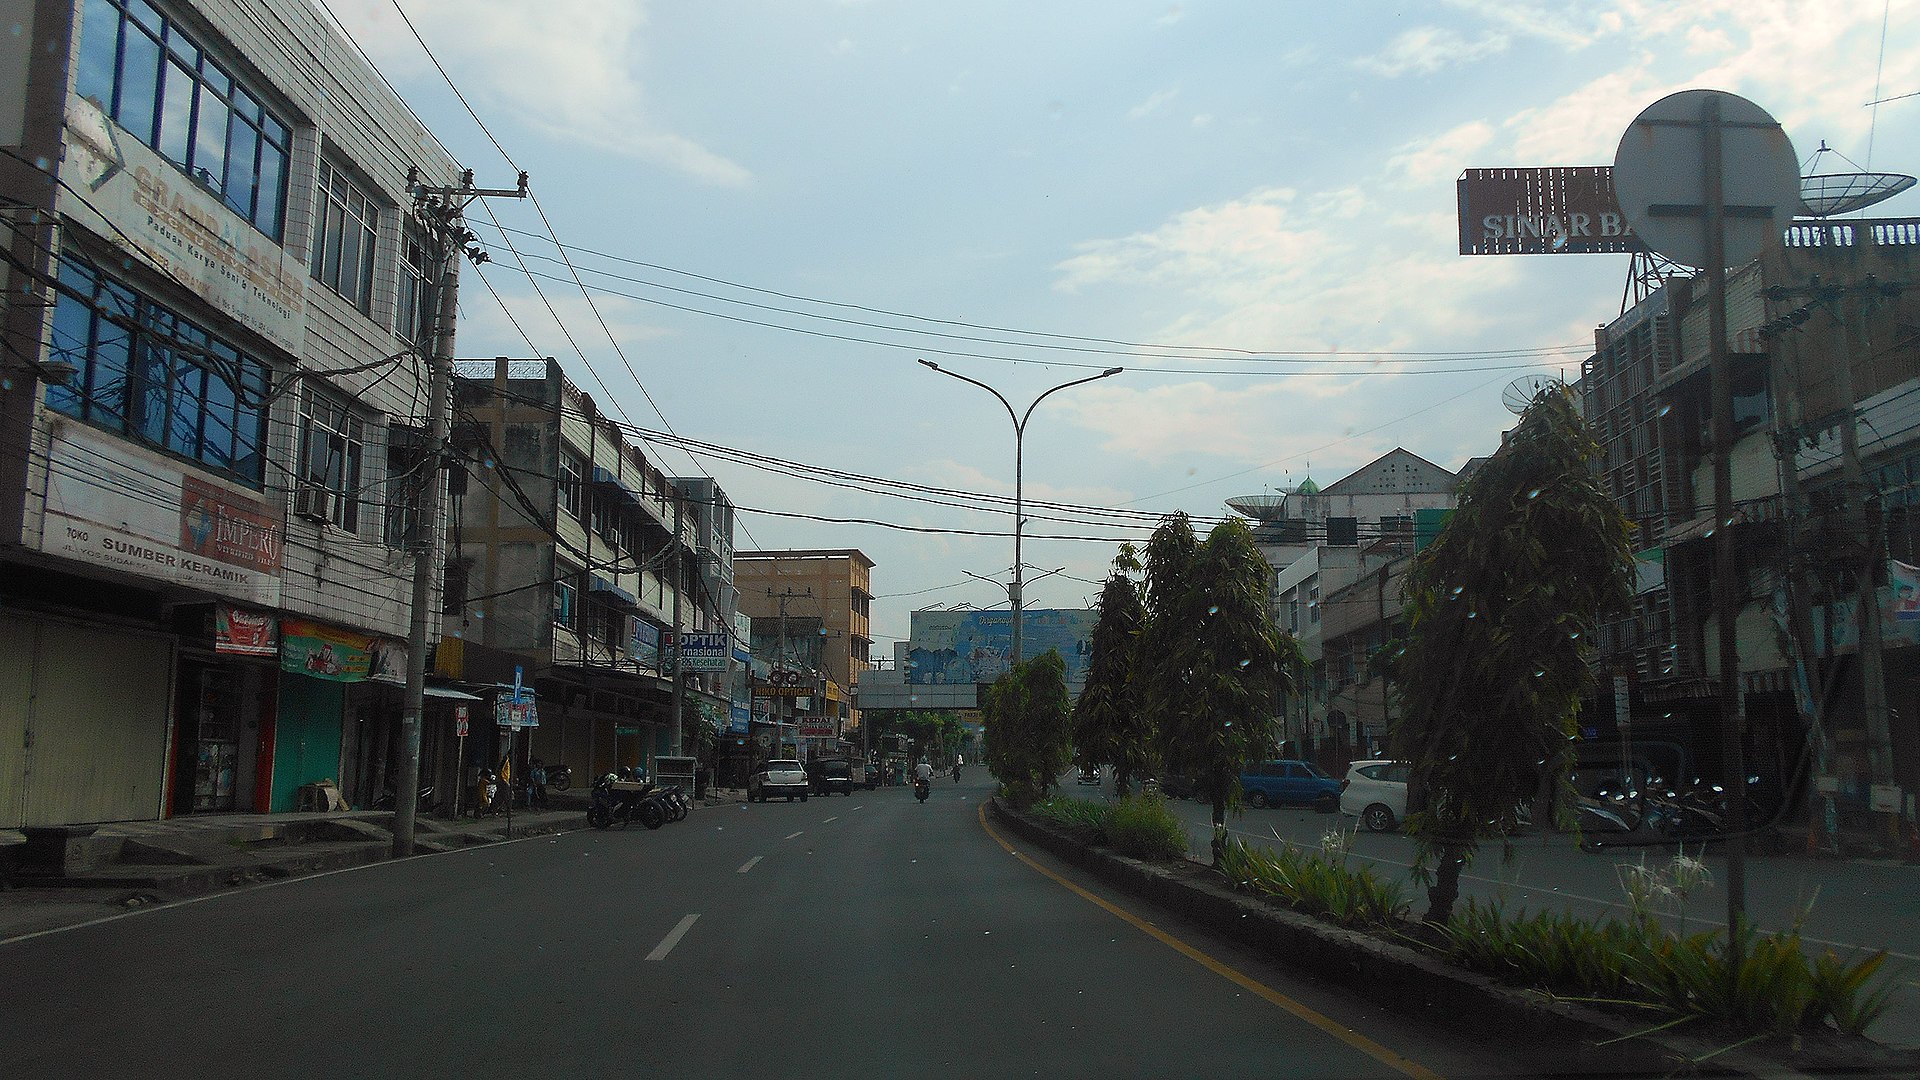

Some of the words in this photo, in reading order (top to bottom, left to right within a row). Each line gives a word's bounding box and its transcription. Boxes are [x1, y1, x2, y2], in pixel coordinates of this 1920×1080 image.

[135, 164, 219, 241] GRAND
[1482, 212, 1592, 239] SINAR
[139, 195, 251, 277] EXCLUSIVE
[265, 285, 299, 311] TILE
[147, 216, 183, 247] Paduan
[187, 243, 215, 270] Karya
[220, 265, 239, 283] Seni
[252, 286, 291, 320] Teknologi
[65, 526, 88, 542] TOKO
[101, 536, 176, 567] SUMBER
[179, 557, 249, 585] KERAMIK
[214, 502, 279, 561] IMPERO
[680, 634, 726, 646] OPTIK
[778, 687, 813, 696] OPTICAL
